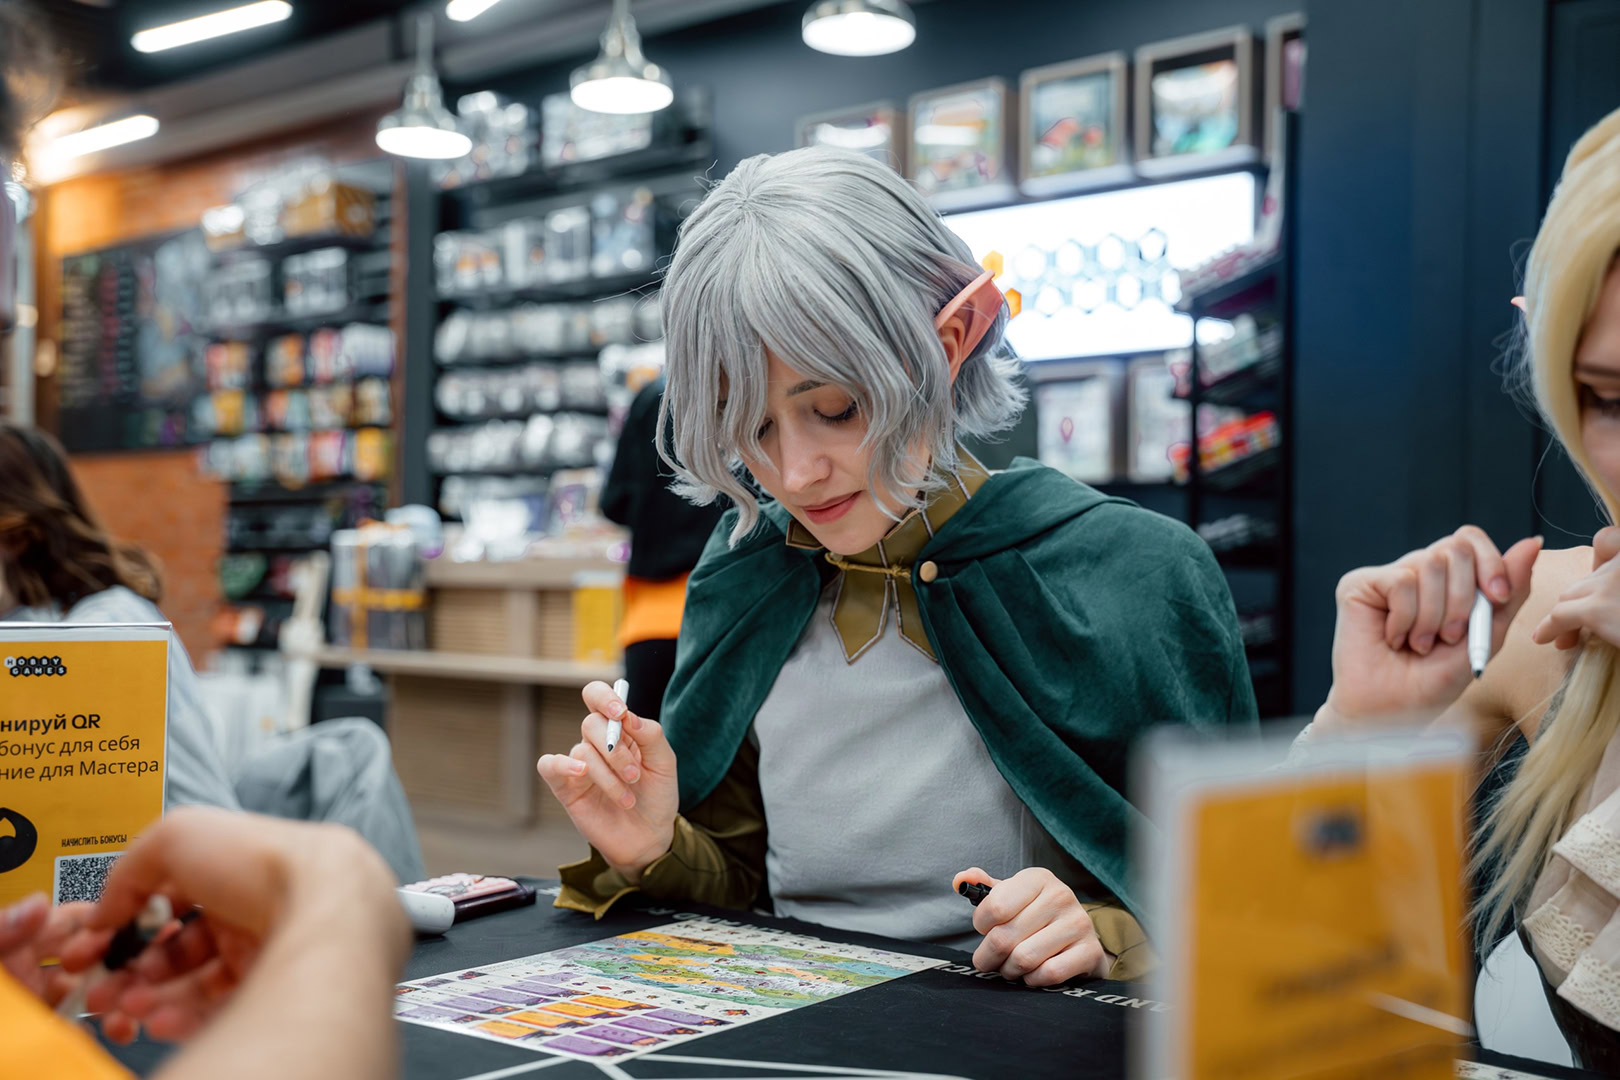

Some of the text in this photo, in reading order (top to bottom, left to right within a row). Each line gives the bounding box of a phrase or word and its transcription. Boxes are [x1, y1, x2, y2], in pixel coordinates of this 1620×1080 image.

[5, 657, 61, 667] HOBBY
[10, 666, 66, 675] GAMES
[71, 714, 101, 729] QR
[0, 735, 140, 759] бонус для себя
[39, 764, 74, 781] для
[79, 759, 159, 777] Мастера
[61, 834, 127, 847] НАЧИСЛИТЬ БОНУСЫ
